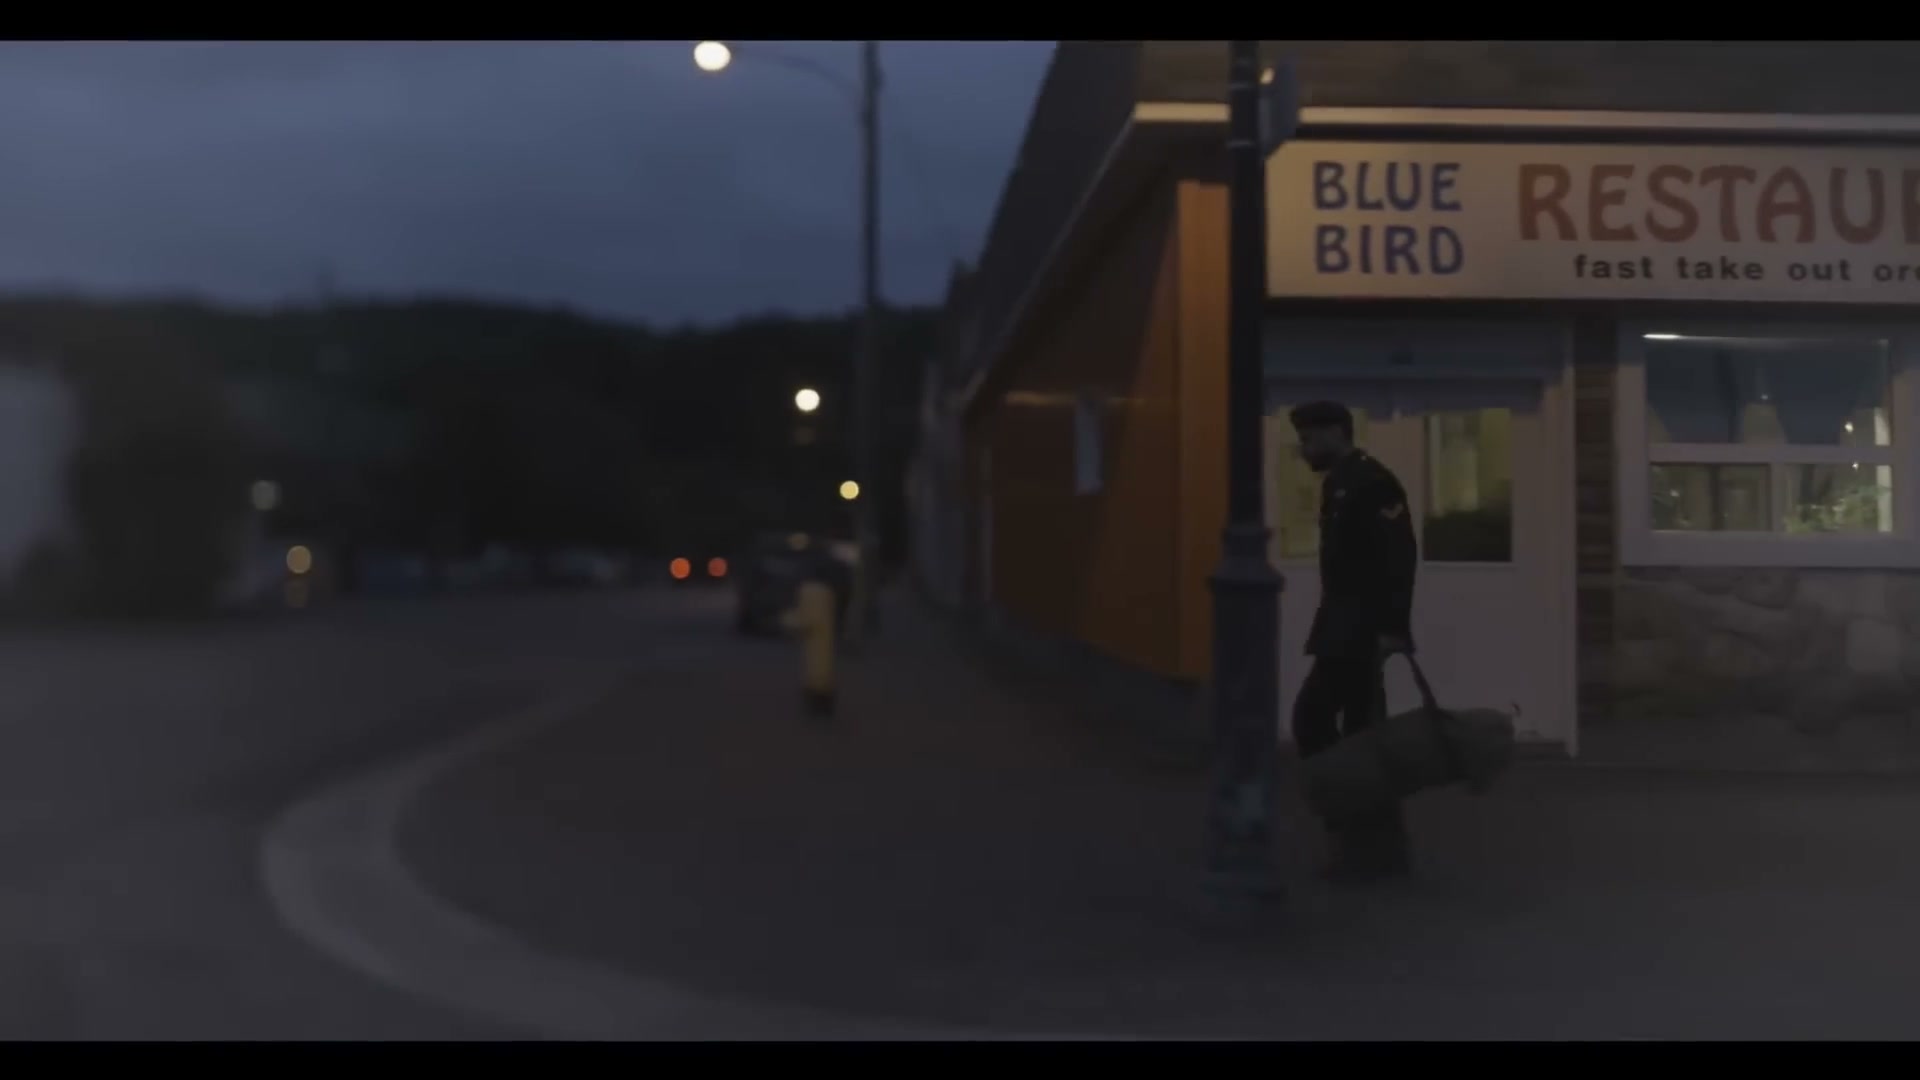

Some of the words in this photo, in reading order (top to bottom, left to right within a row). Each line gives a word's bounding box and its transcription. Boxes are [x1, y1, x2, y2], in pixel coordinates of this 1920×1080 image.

[1313, 161, 1462, 211] BLUE
[1315, 224, 1464, 275] BIRD
[1573, 253, 1654, 280] fast
[1676, 256, 1764, 282] take
[1787, 259, 1853, 283] out
